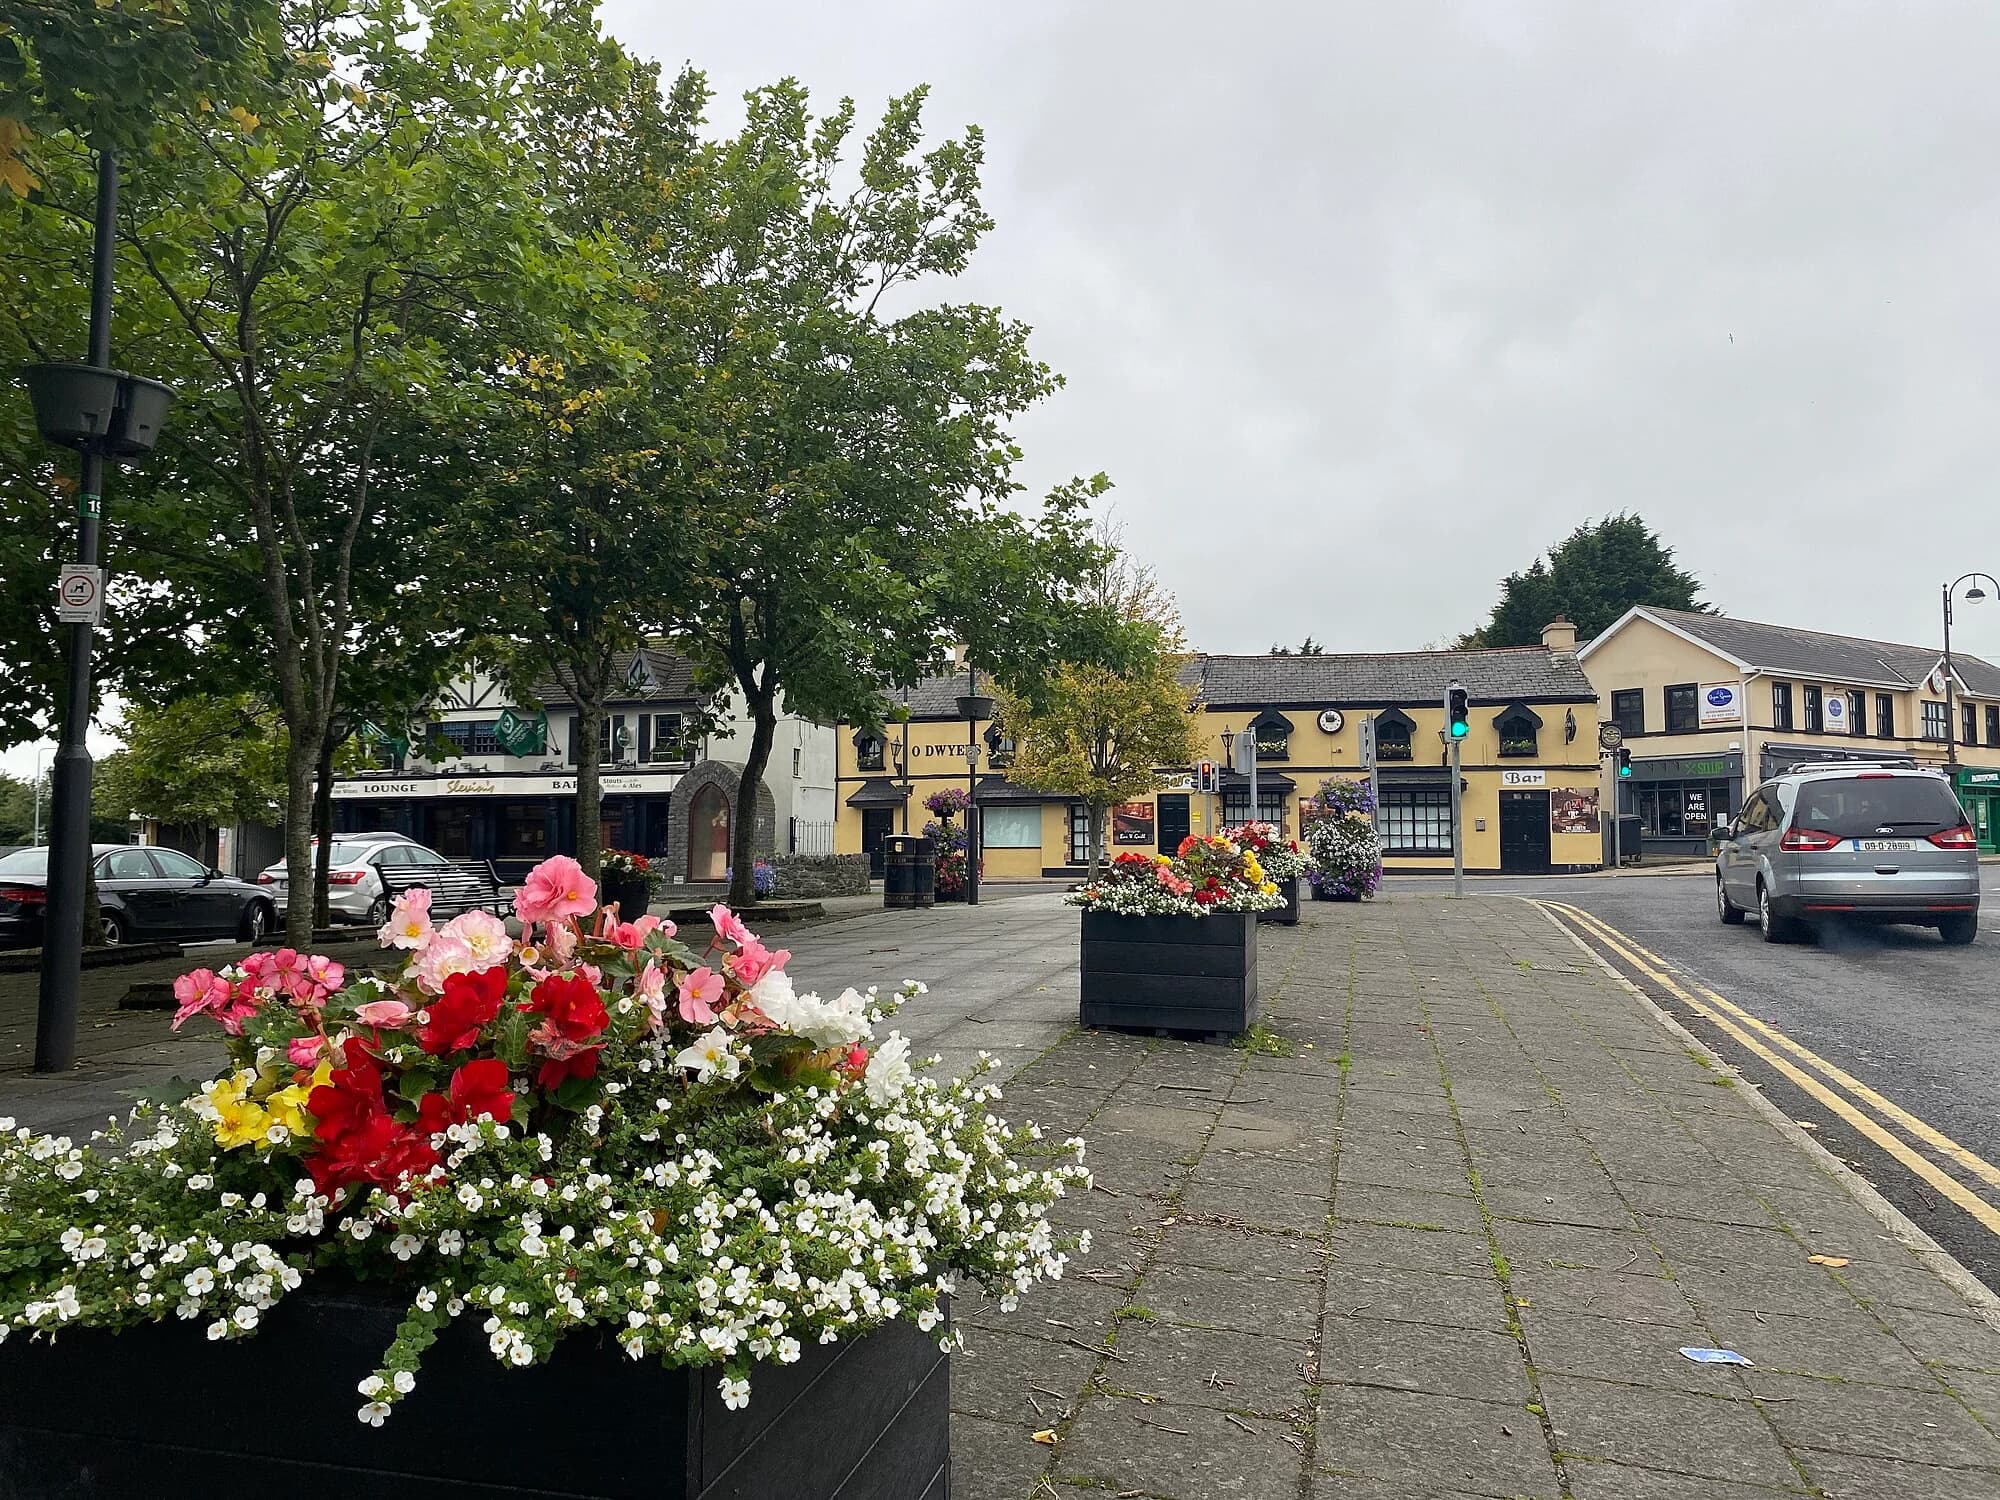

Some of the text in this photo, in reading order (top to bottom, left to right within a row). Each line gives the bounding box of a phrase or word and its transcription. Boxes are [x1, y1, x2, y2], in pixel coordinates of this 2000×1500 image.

[1505, 772, 1542, 784] Bar
[364, 784, 418, 793] LOUNGE
[1689, 793, 1703, 801] WE
[1687, 803, 1705, 811] ARE
[1684, 812, 1707, 820] OPEN
